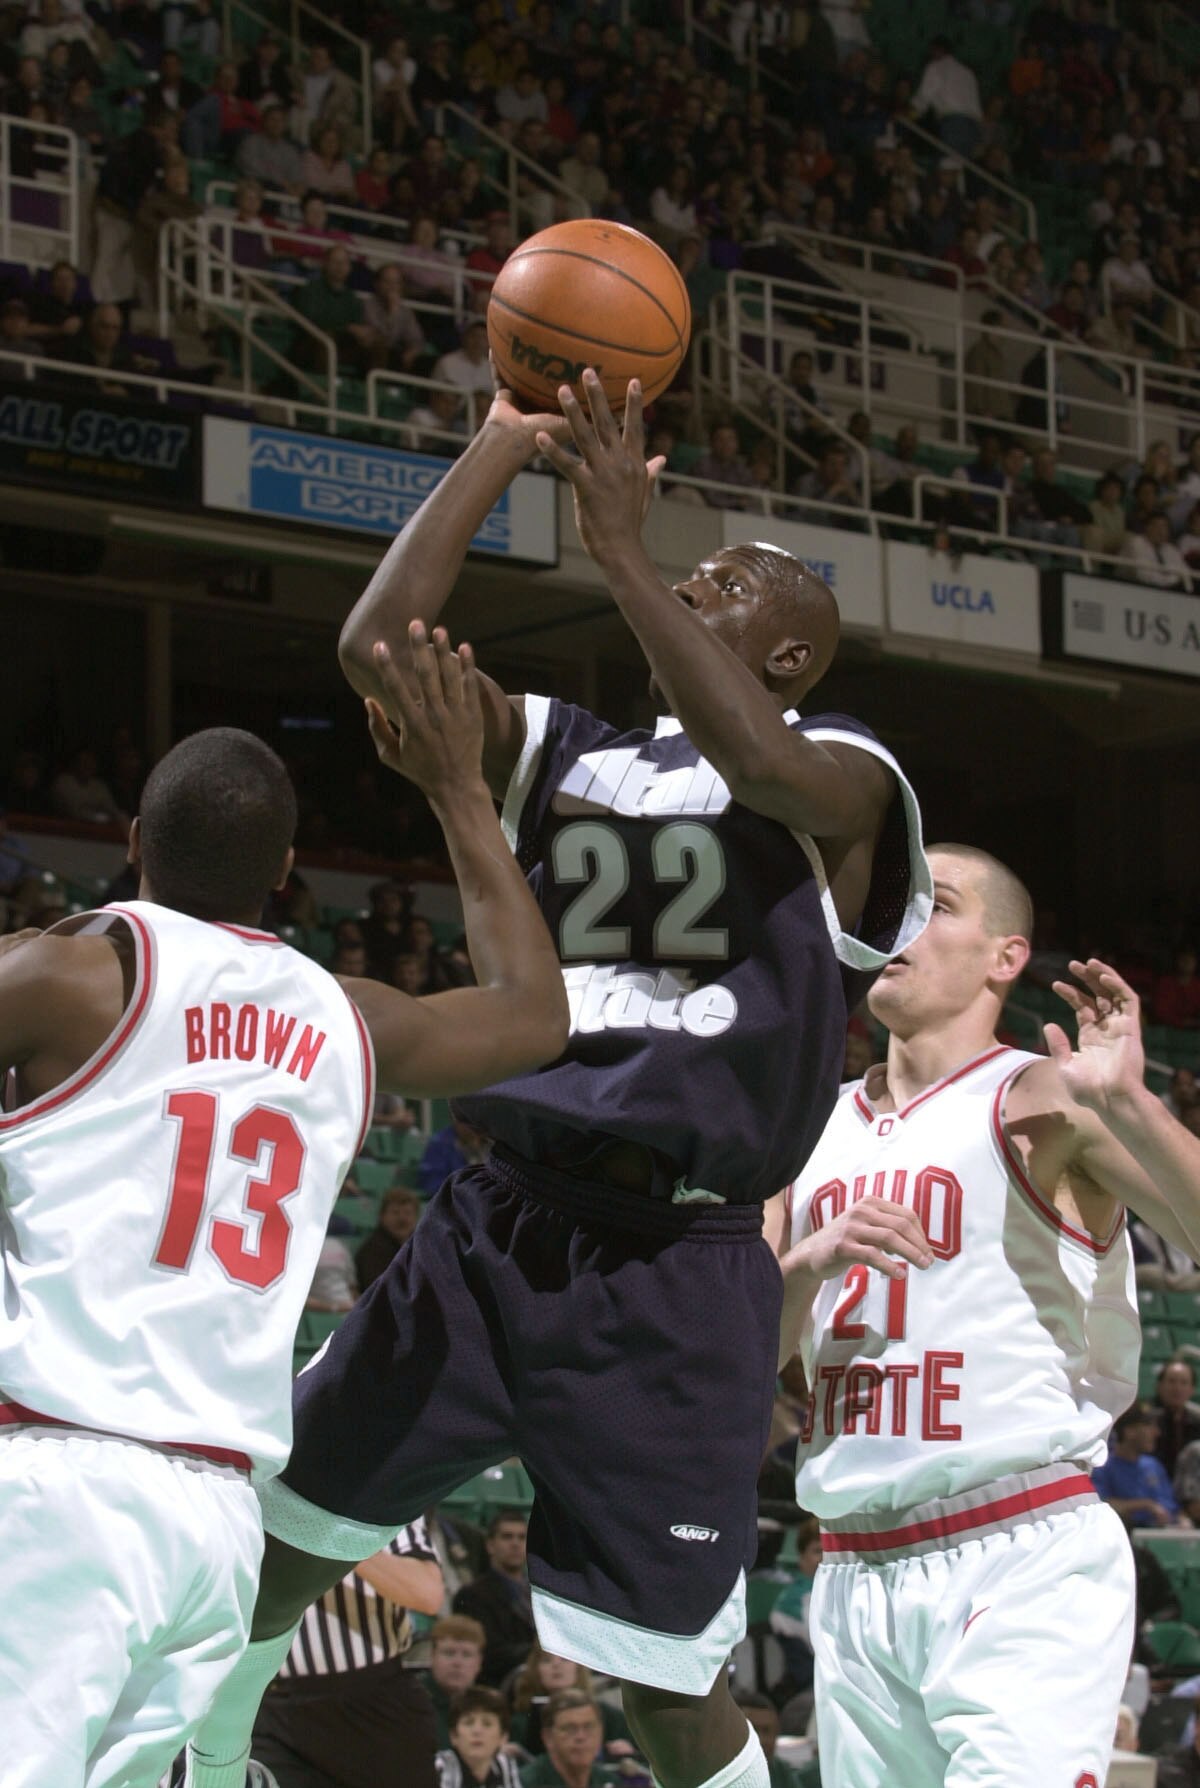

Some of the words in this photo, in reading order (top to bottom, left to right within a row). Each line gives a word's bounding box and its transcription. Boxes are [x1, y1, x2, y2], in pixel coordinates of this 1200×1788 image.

[0, 395, 64, 450] ALL
[66, 409, 190, 470] SPORT
[251, 440, 447, 491] AMERIC
[306, 483, 510, 538] EXPS
[931, 581, 995, 615] UCLA
[551, 820, 729, 961] 22
[185, 1002, 327, 1082] BROWN
[149, 1086, 309, 1296] 13
[831, 1261, 909, 1343] 21
